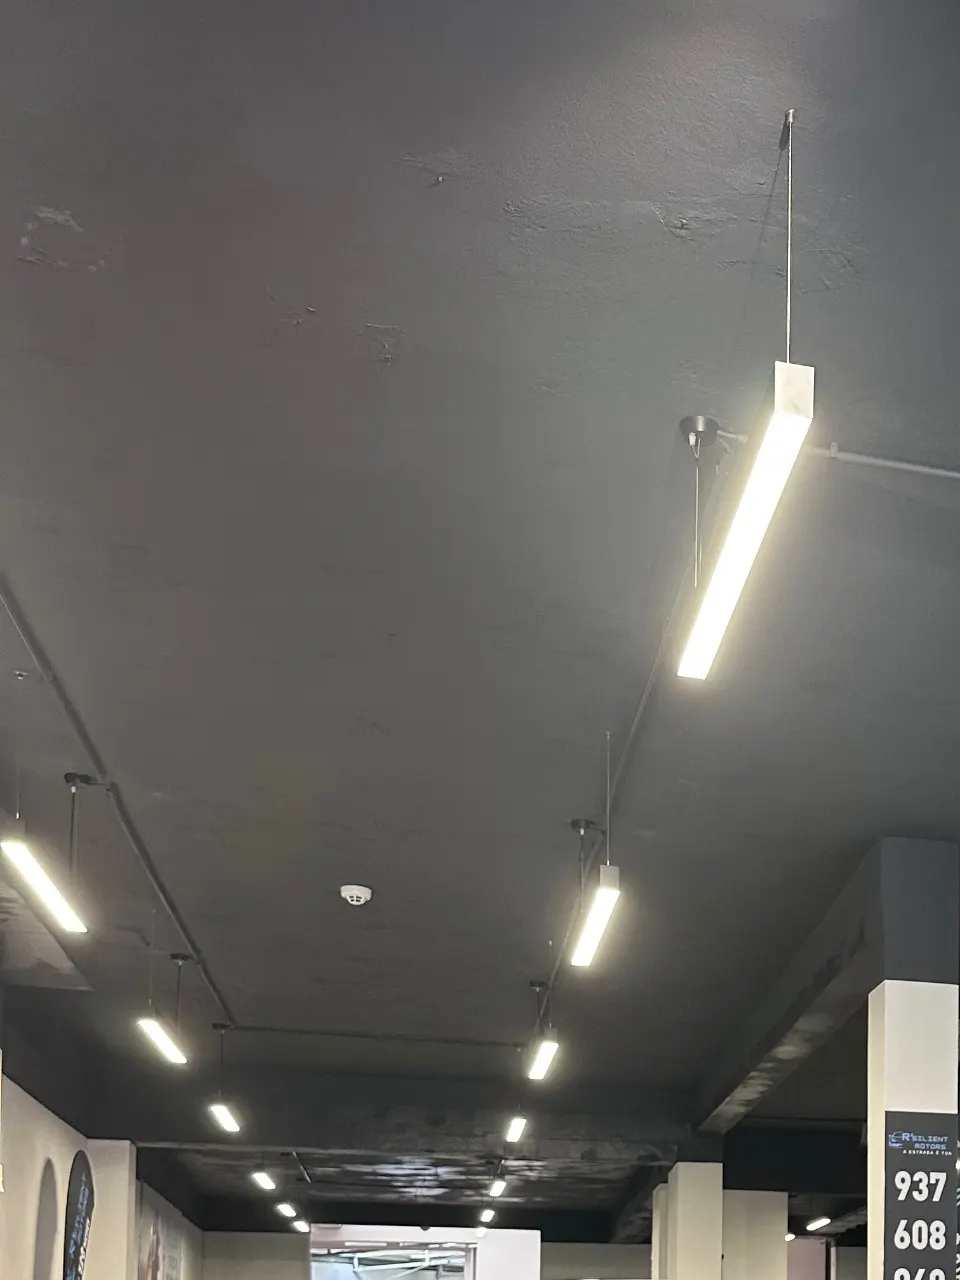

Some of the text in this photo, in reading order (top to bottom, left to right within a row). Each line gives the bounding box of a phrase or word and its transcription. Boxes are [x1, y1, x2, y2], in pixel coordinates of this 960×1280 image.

[901, 1132, 949, 1142] R'SILIENT
[894, 1170, 947, 1202] 937
[894, 1219, 946, 1250] 608
